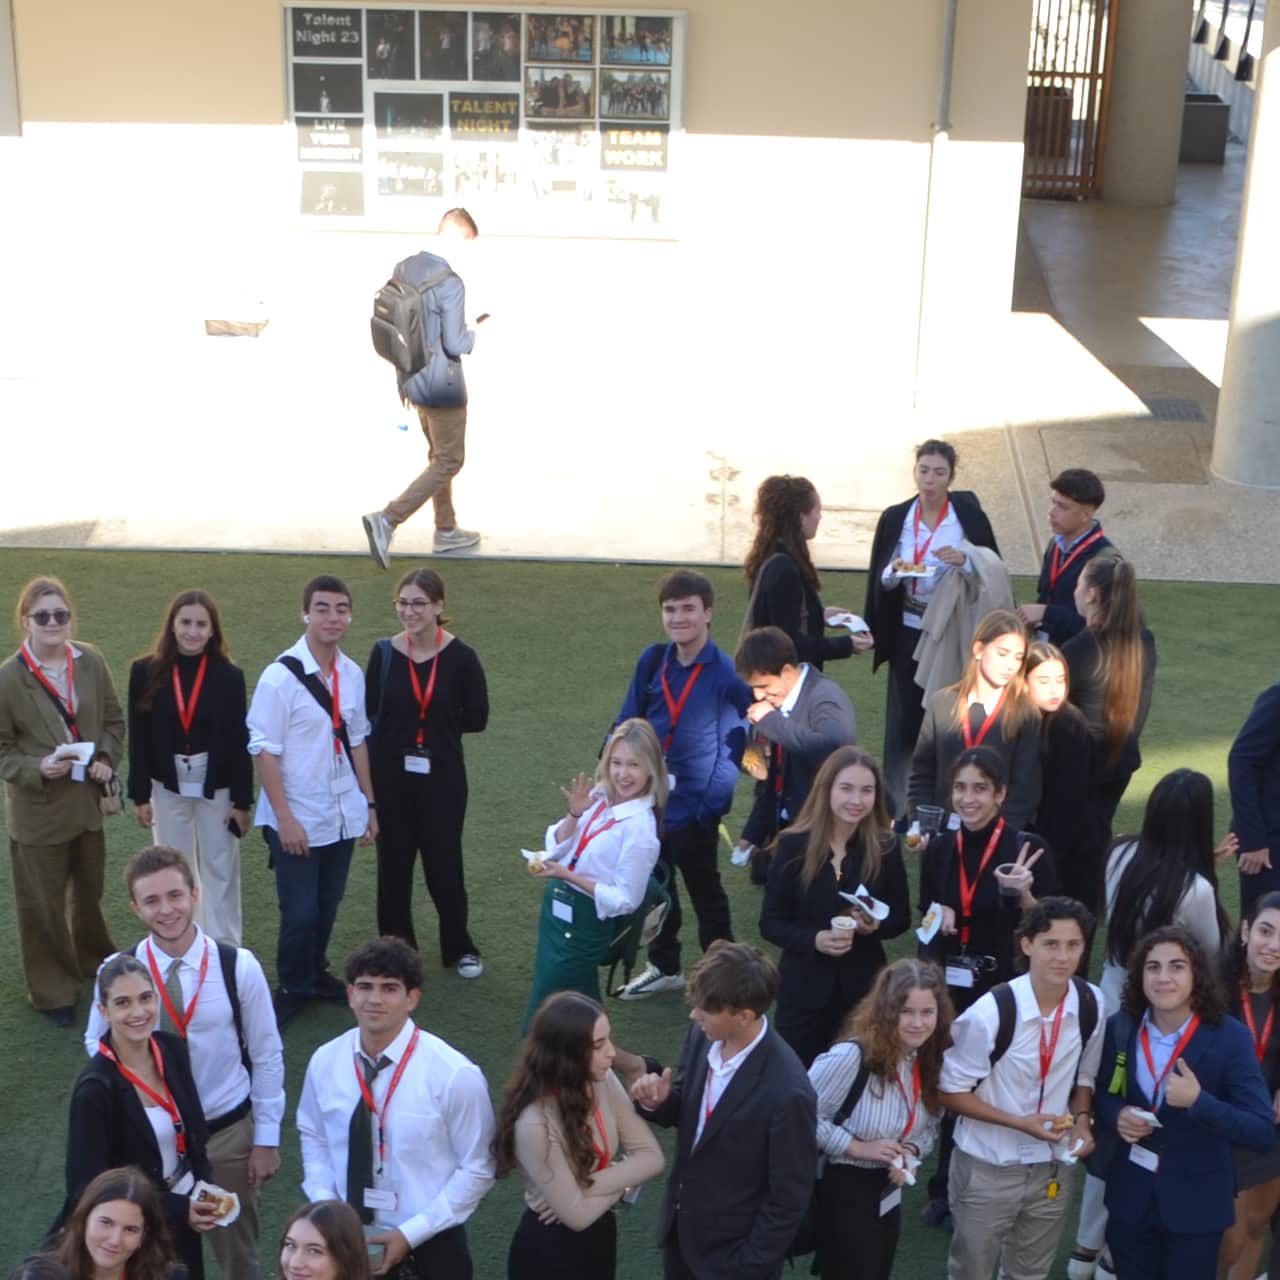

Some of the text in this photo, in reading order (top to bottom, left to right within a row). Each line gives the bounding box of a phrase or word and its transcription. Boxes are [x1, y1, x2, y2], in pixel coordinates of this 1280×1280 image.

[302, 12, 352, 27] Talent
[295, 30, 360, 46] Night 23
[450, 99, 518, 114] TALENT
[314, 119, 347, 130] LIVE
[456, 118, 513, 133] NIGHT
[607, 130, 662, 146] TEAM
[604, 149, 665, 167] WORK
